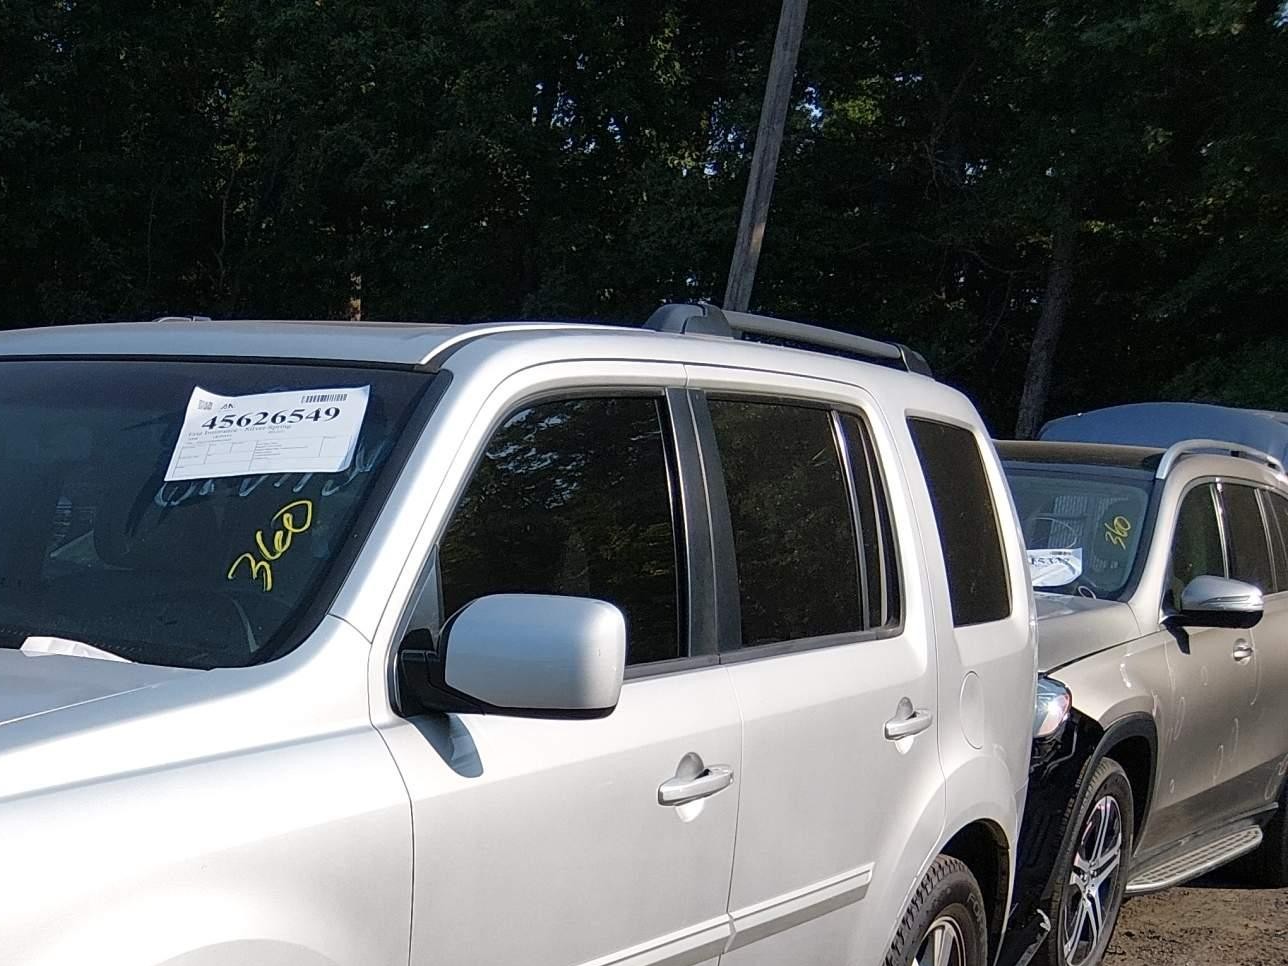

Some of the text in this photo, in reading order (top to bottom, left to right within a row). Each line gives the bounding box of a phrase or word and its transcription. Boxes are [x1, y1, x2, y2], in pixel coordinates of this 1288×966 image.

[201, 407, 340, 430] 45626549
[227, 499, 312, 592] 360
[1104, 515, 1131, 550] 360
